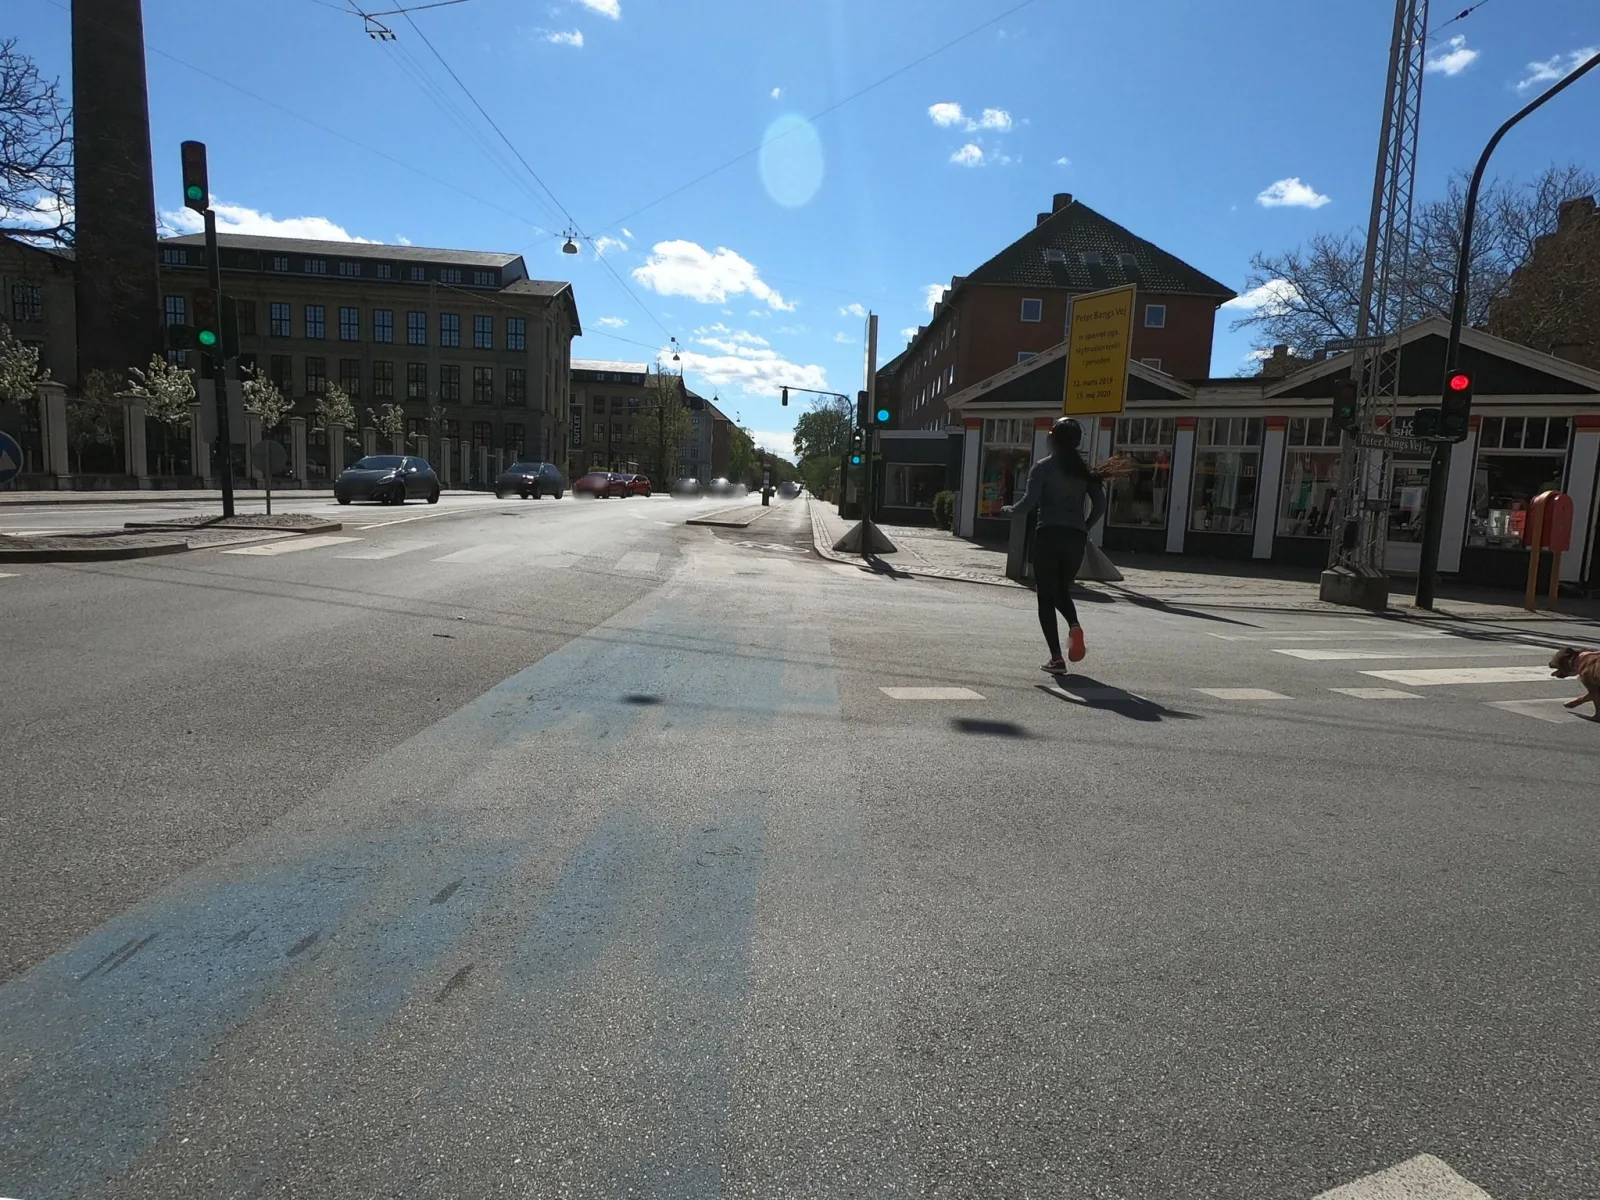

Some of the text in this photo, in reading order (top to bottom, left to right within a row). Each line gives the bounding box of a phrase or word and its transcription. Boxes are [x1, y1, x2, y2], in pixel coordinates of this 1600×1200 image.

[1076, 306, 1127, 323] Peter Bangs Vej
[1099, 376, 1114, 385] 2019
[1086, 391, 1096, 400] maj
[1097, 389, 1111, 398] 2020
[1361, 434, 1382, 446] Peter
[1384, 437, 1408, 450] Bangs
[1409, 440, 1422, 453] Vej
